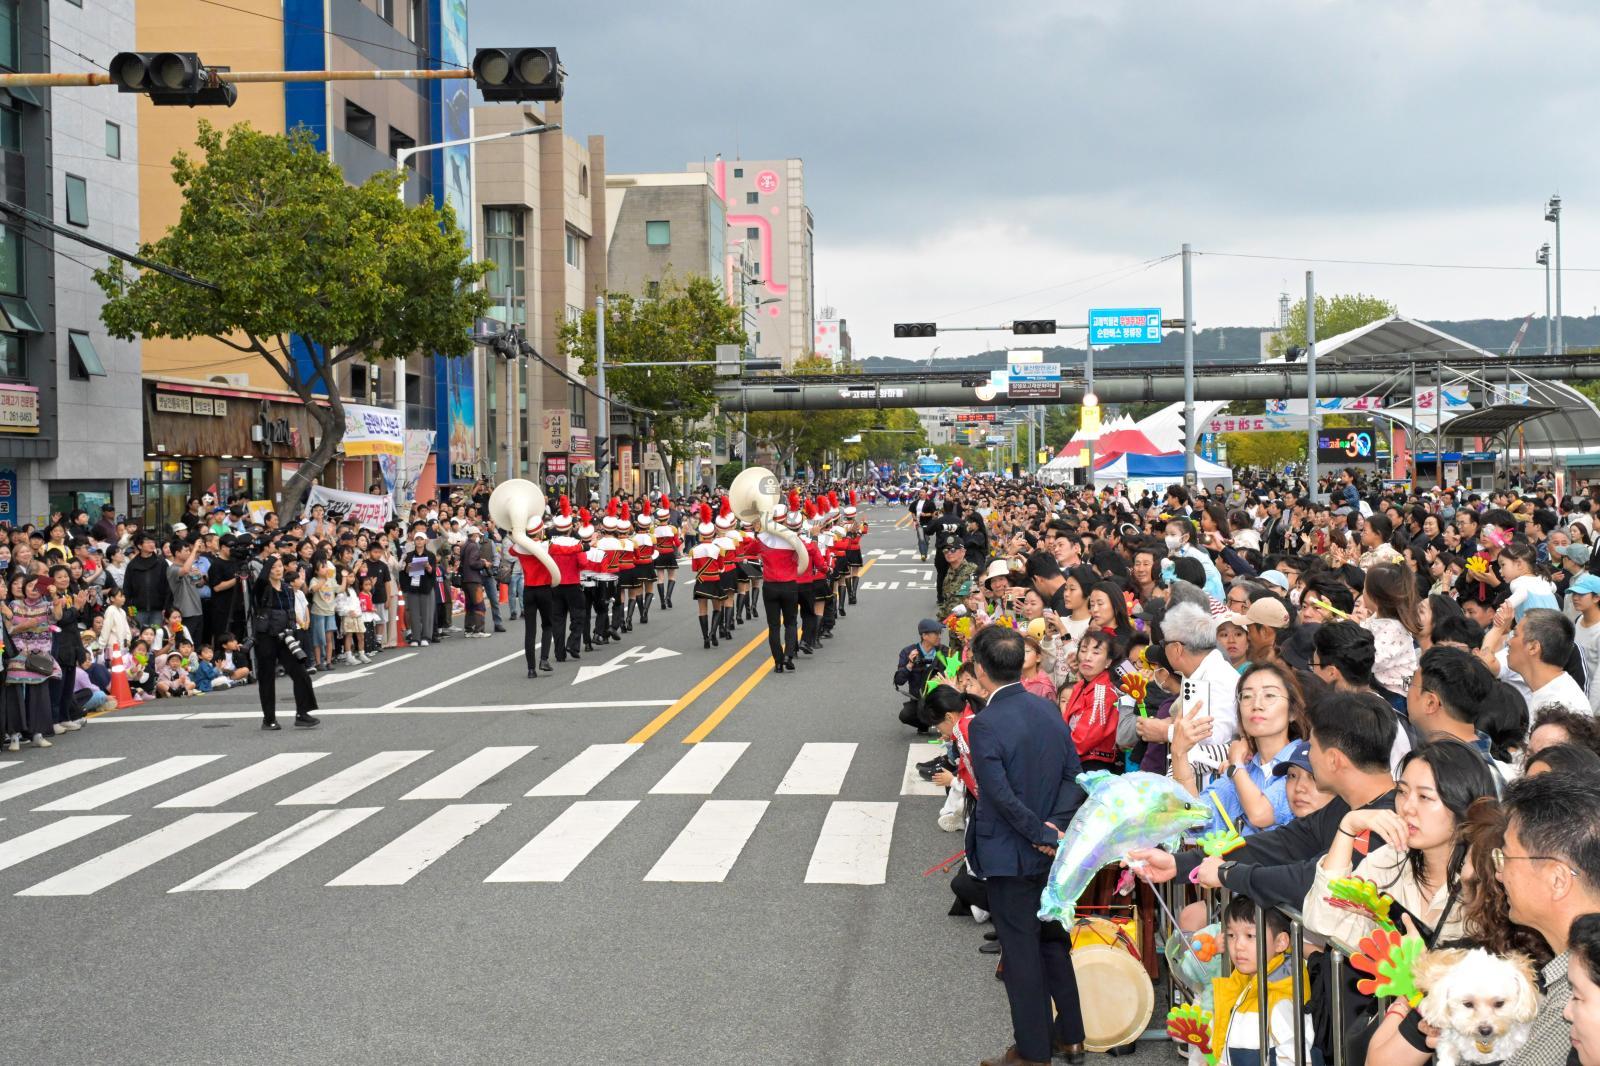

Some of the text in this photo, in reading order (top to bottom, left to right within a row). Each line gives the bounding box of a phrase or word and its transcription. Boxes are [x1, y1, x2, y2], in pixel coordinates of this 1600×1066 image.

[1097, 327, 1142, 338] 순환버스 정류장
[852, 388, 904, 398] 고래문화마을
